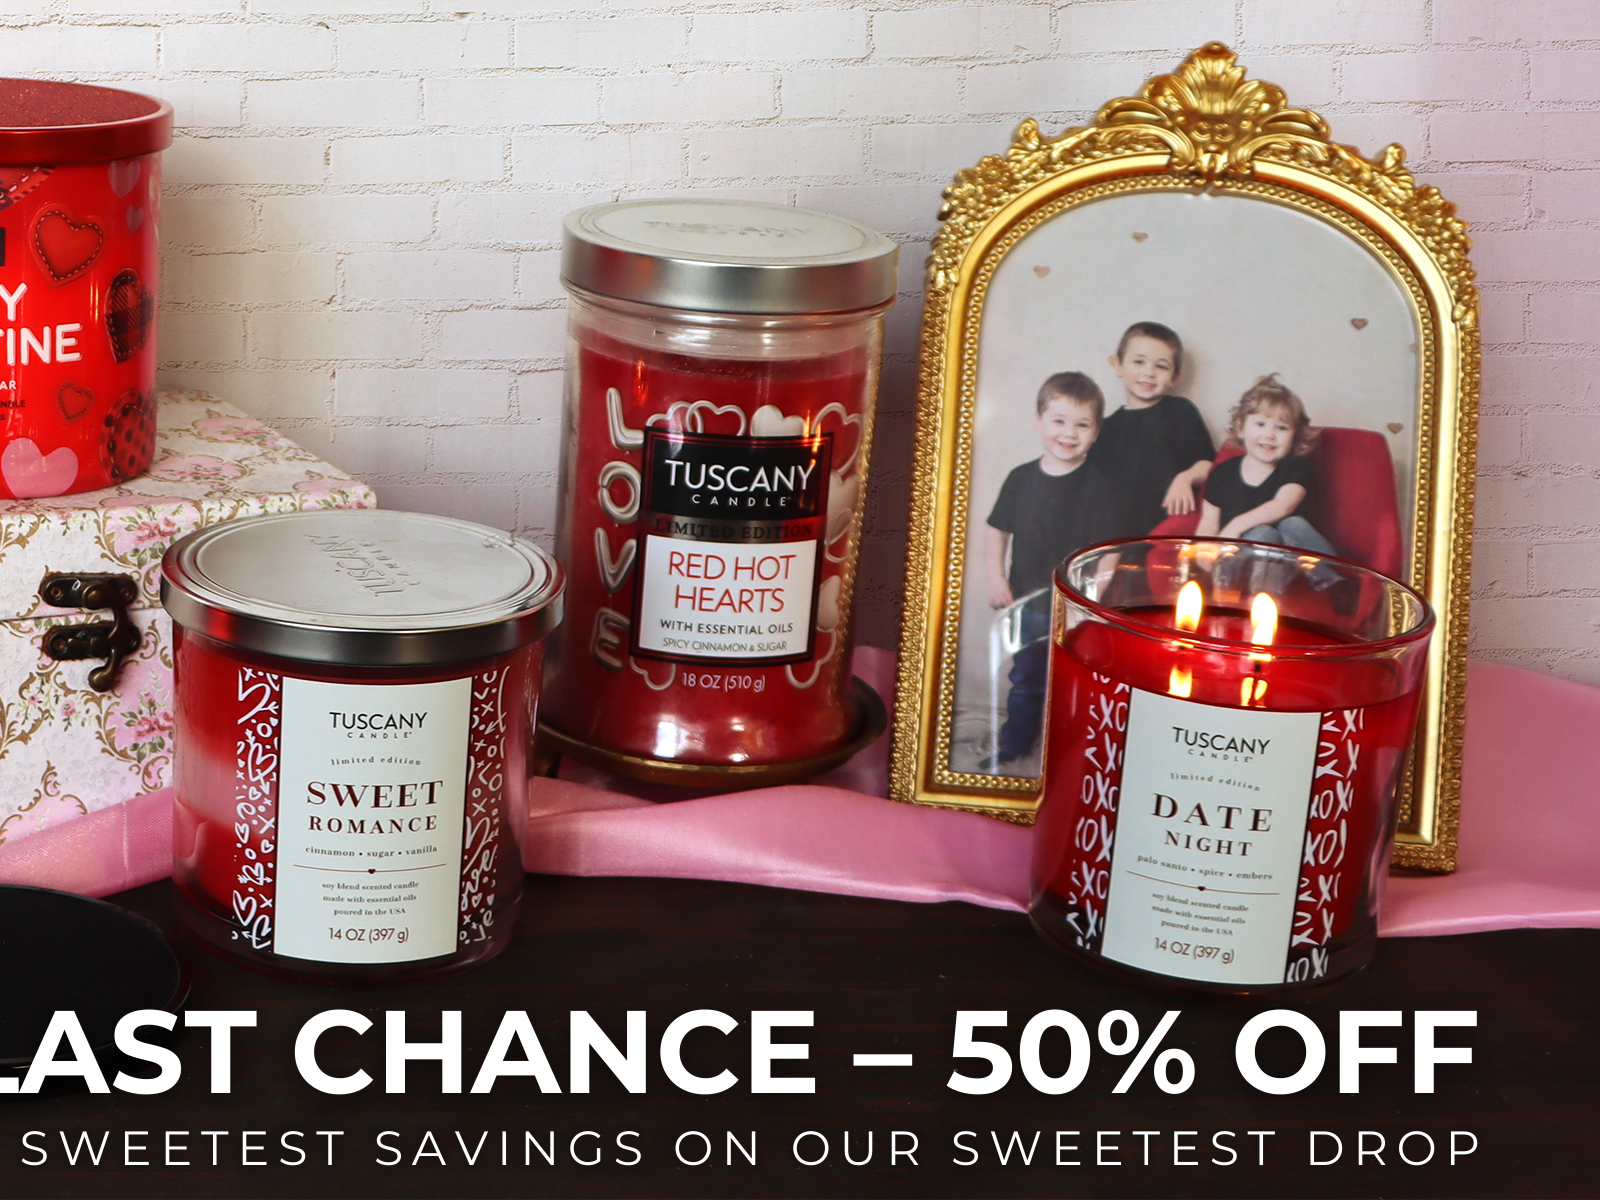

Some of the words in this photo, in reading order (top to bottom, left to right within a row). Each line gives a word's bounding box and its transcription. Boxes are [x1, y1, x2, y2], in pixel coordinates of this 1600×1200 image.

[665, 459, 815, 492] TUSCANY
[692, 494, 791, 507] CANDLE
[654, 519, 734, 539] LIMITED
[741, 523, 814, 539] EDITION
[669, 551, 726, 580] RED
[734, 554, 797, 581] HOT
[674, 584, 785, 613] HEARTS
[660, 619, 693, 632] WITH
[698, 623, 764, 635] ESSENTIAL
[768, 622, 794, 634] OILS
[663, 637, 690, 649] SPICY
[692, 640, 748, 652] CINNAMON
[757, 641, 787, 652] SUGAR
[683, 673, 696, 687] 18
[700, 674, 721, 689] OZ
[725, 675, 751, 692] (510
[753, 674, 766, 693] g)
[329, 711, 428, 730] TUSCANY
[347, 731, 412, 739] CANDLE
[1172, 726, 1271, 755] TUSCANY
[331, 756, 374, 766] limited
[380, 756, 421, 766] edition
[1188, 748, 1253, 763] CANDLE
[1170, 772, 1214, 783] limited
[1218, 778, 1261, 792] edition
[307, 780, 443, 808] SWEET
[1151, 792, 1273, 832] DATE
[308, 815, 437, 834] ROMANCE
[305, 845, 355, 857] cinnamon
[366, 849, 395, 858] sugar
[405, 844, 438, 855] vanilla
[1164, 829, 1253, 856] NIGHT
[1137, 853, 1159, 864] palo
[1160, 861, 1188, 871] santo
[1199, 868, 1226, 877] spice
[1236, 871, 1273, 880] embers
[337, 881, 360, 890] blend
[361, 881, 392, 890] scented
[393, 880, 420, 889] candle
[347, 893, 365, 903] with
[366, 894, 401, 903] essential
[402, 892, 417, 901] oils
[1151, 891, 1165, 900] soy
[1166, 894, 1189, 905] blend
[1190, 900, 1222, 910] scented
[1222, 904, 1250, 912] candle
[333, 908, 363, 916] poured
[364, 907, 374, 915] in
[374, 907, 388, 915] the
[389, 907, 407, 915] USA
[1152, 904, 1174, 915] made
[1175, 909, 1193, 918] with
[1194, 913, 1230, 923] essential
[1231, 916, 1246, 924] oils
[329, 927, 342, 940] 14
[345, 928, 366, 941] OZ
[368, 928, 395, 944] (397
[397, 926, 409, 944] g)
[1160, 918, 1190, 931] poured
[1191, 923, 1200, 932] in
[1201, 926, 1215, 934] the
[1216, 927, 1234, 936] USA
[1155, 937, 1168, 951] 14
[1171, 941, 1191, 955] OZ
[1193, 945, 1221, 960] (397
[1222, 949, 1235, 965] g)
